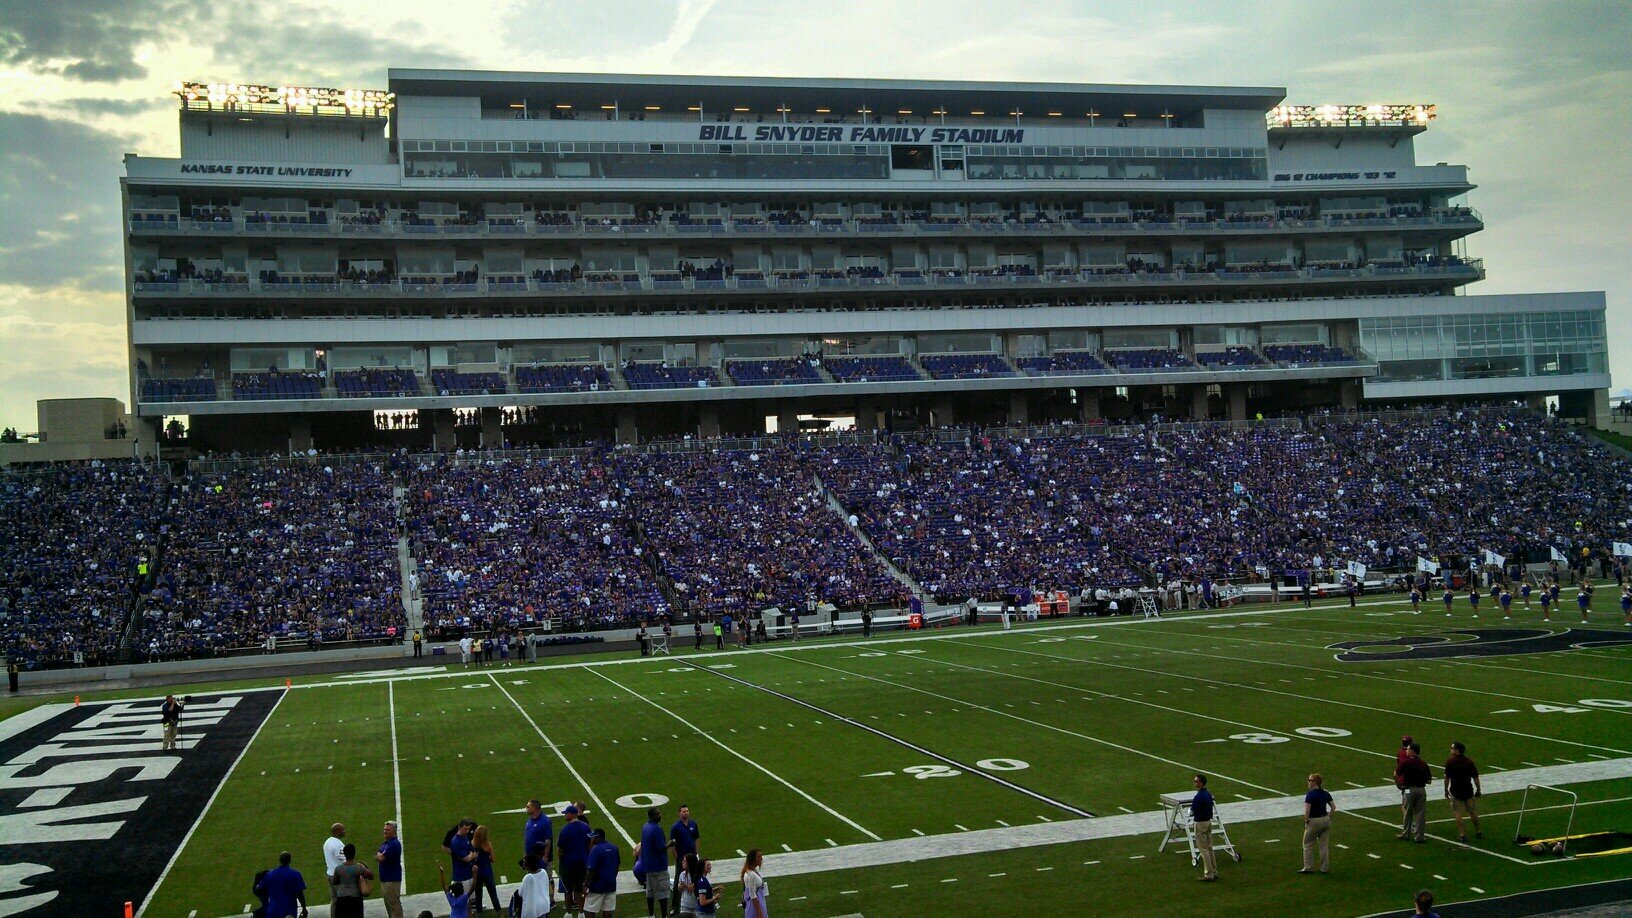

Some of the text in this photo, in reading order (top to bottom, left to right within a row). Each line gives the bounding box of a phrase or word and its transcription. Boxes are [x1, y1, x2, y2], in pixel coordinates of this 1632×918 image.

[699, 125, 1024, 144] BILL SNYDER FAMILY STADIUM
[181, 164, 353, 177] KANSAS STATE UNIVERSITY
[1274, 173, 1291, 181] BIG
[1305, 172, 1360, 181] CHAMPIONS
[1228, 726, 1352, 745] 30
[902, 758, 1030, 780] 20
